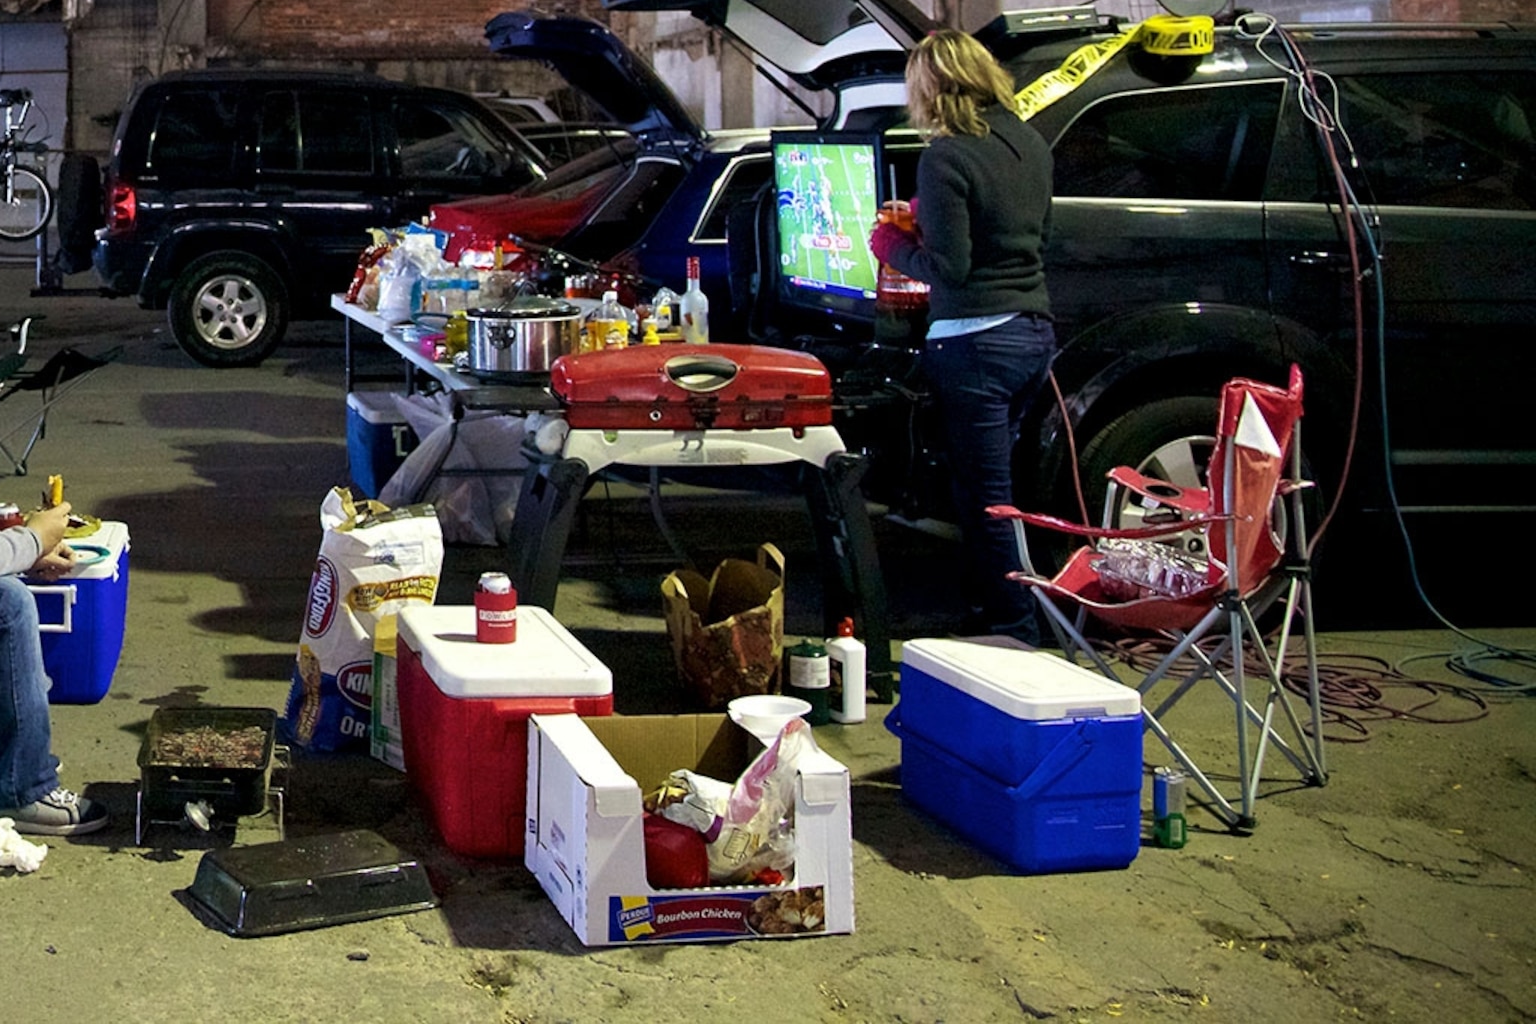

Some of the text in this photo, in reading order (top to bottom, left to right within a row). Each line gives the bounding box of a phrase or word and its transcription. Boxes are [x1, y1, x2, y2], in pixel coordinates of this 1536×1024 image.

[308, 562, 332, 631] KINGSFORD
[620, 907, 650, 922] PERDUE
[656, 908, 742, 925] Bourbon Chicken
